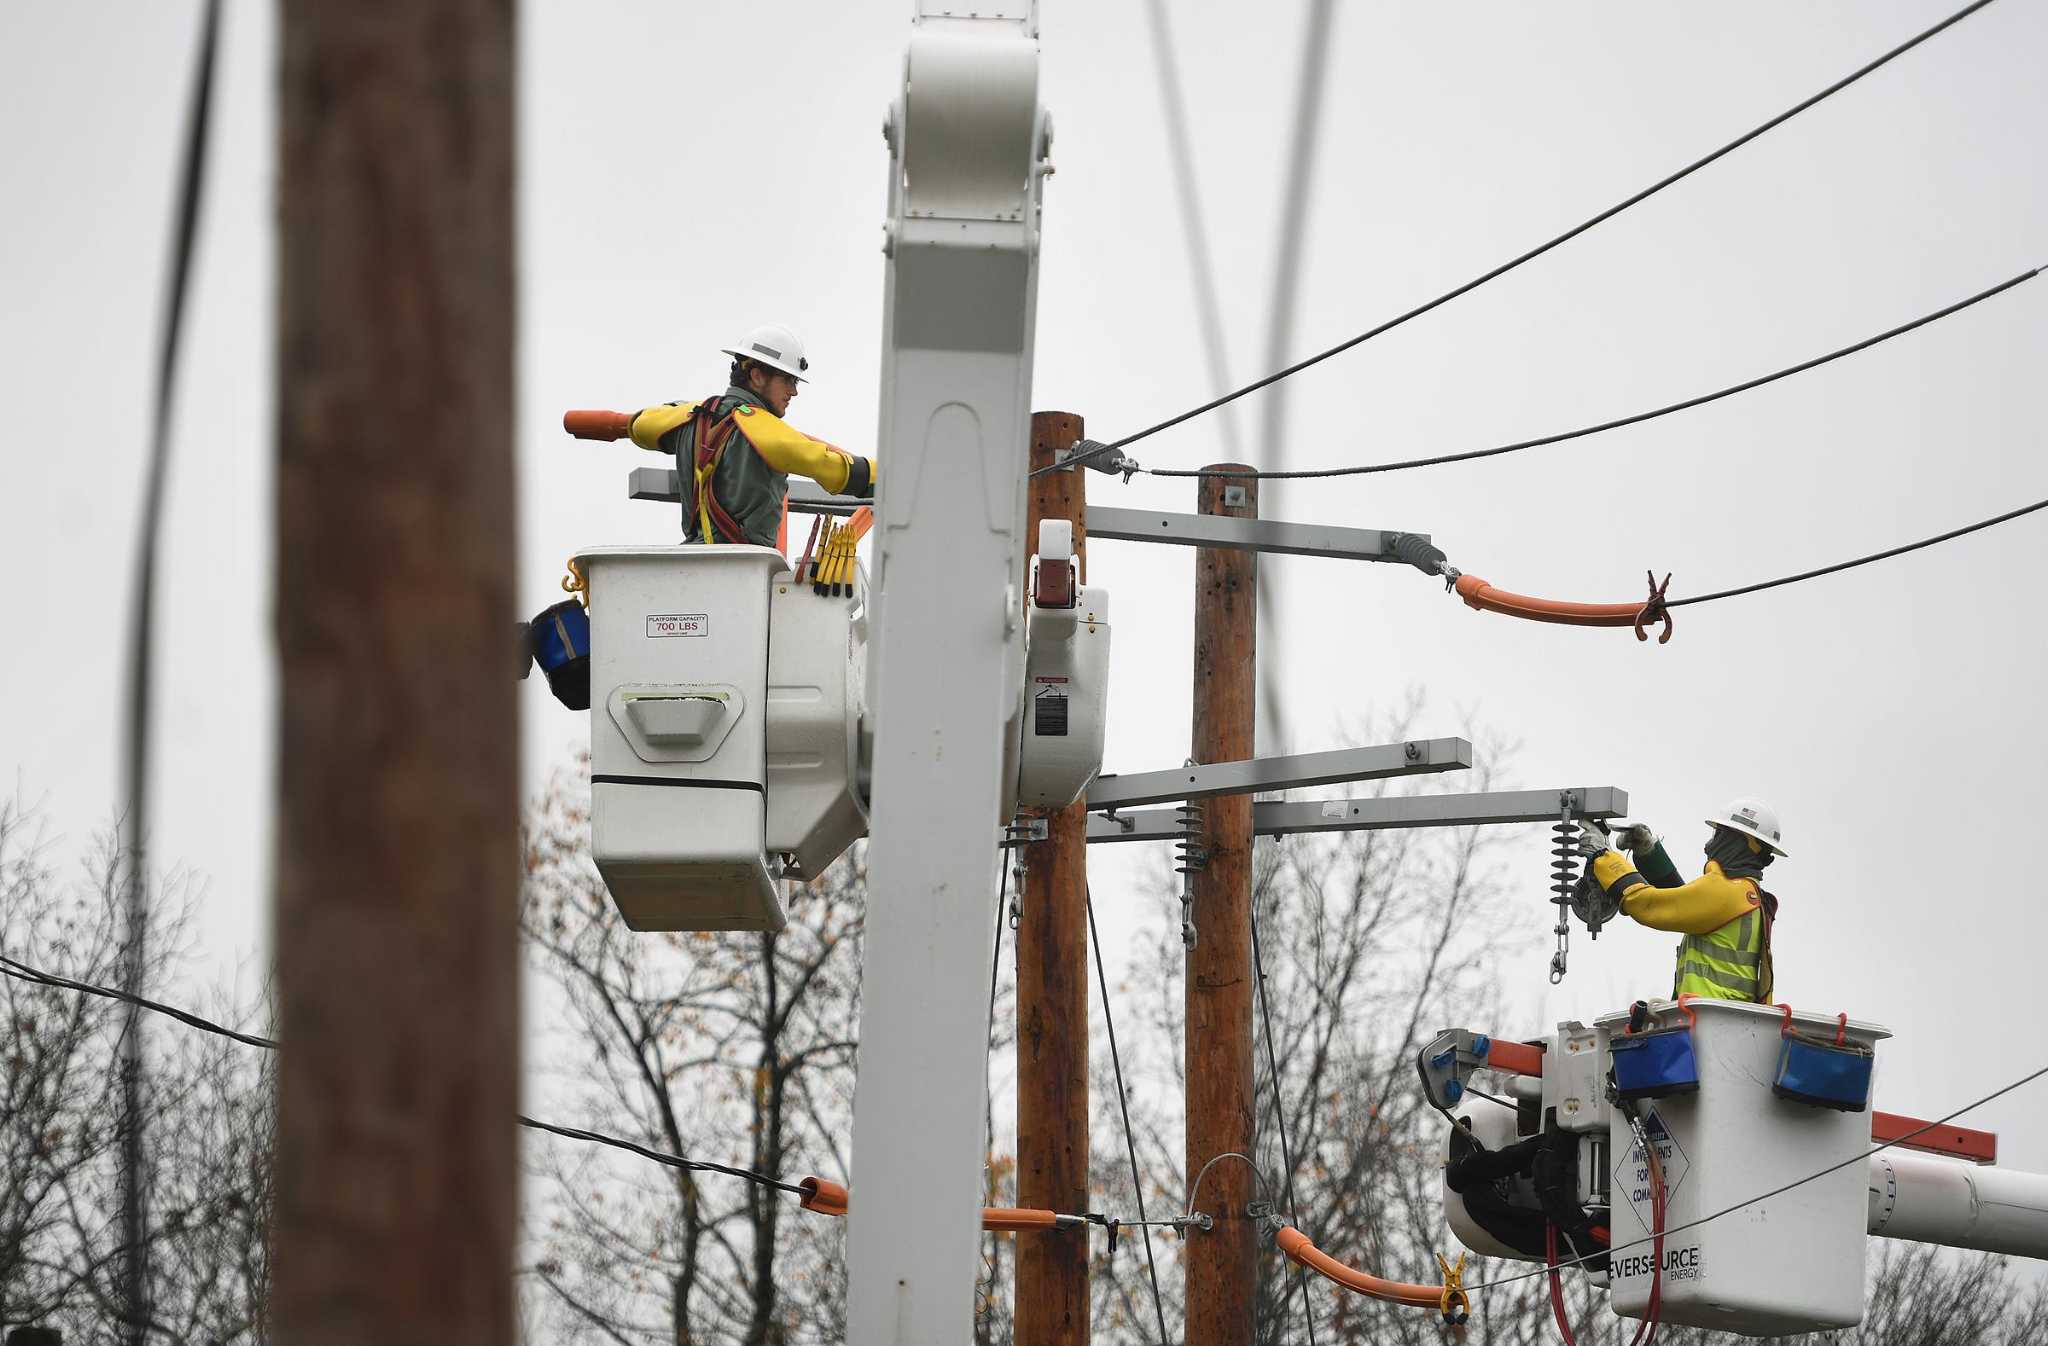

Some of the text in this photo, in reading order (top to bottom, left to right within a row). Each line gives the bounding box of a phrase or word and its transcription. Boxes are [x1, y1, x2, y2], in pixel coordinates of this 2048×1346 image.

[656, 622, 698, 631] 700 LBS
[1671, 1267, 1698, 1281] ENERGY
